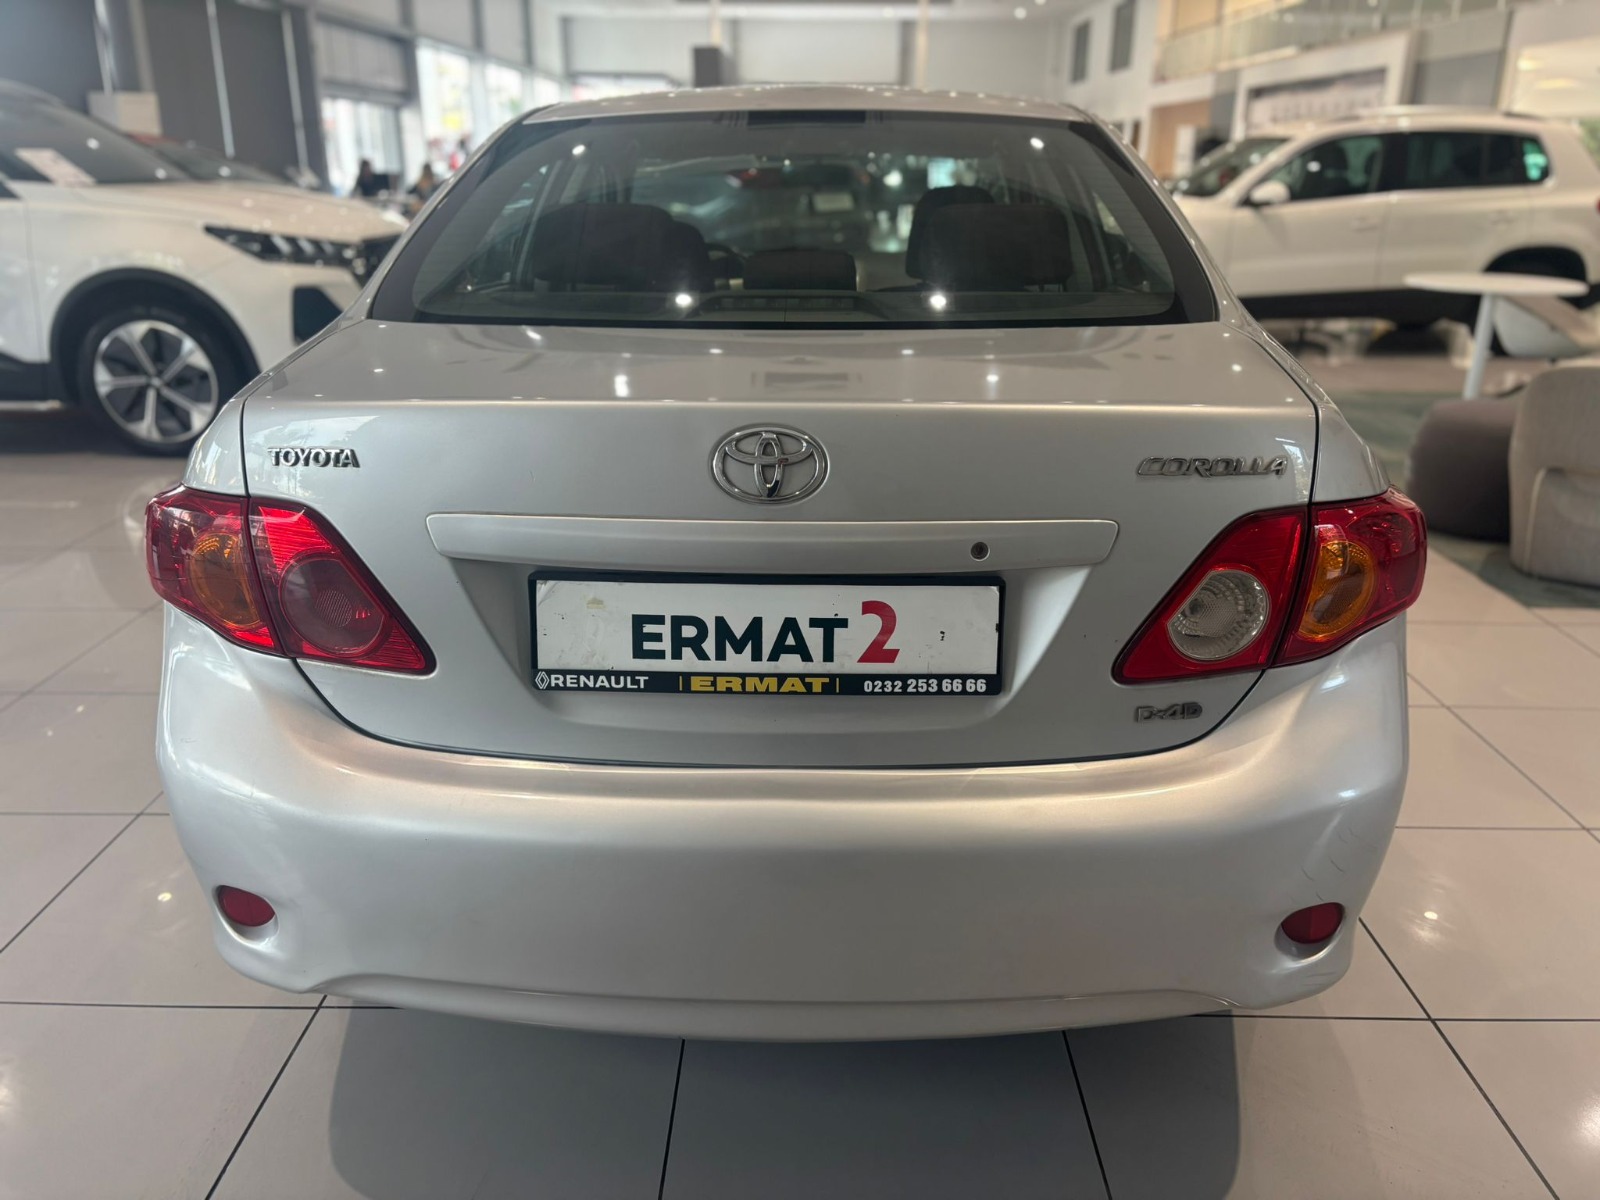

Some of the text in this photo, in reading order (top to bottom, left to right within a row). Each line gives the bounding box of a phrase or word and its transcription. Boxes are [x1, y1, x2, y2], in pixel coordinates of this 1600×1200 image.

[268, 447, 360, 468] TOYOTA
[1136, 455, 1289, 478] COROLLA
[631, 600, 901, 664] ERMAT 2
[551, 674, 987, 693] RENAULT ERMAT 0232 253 66 66
[1134, 701, 1203, 722] D-4D
